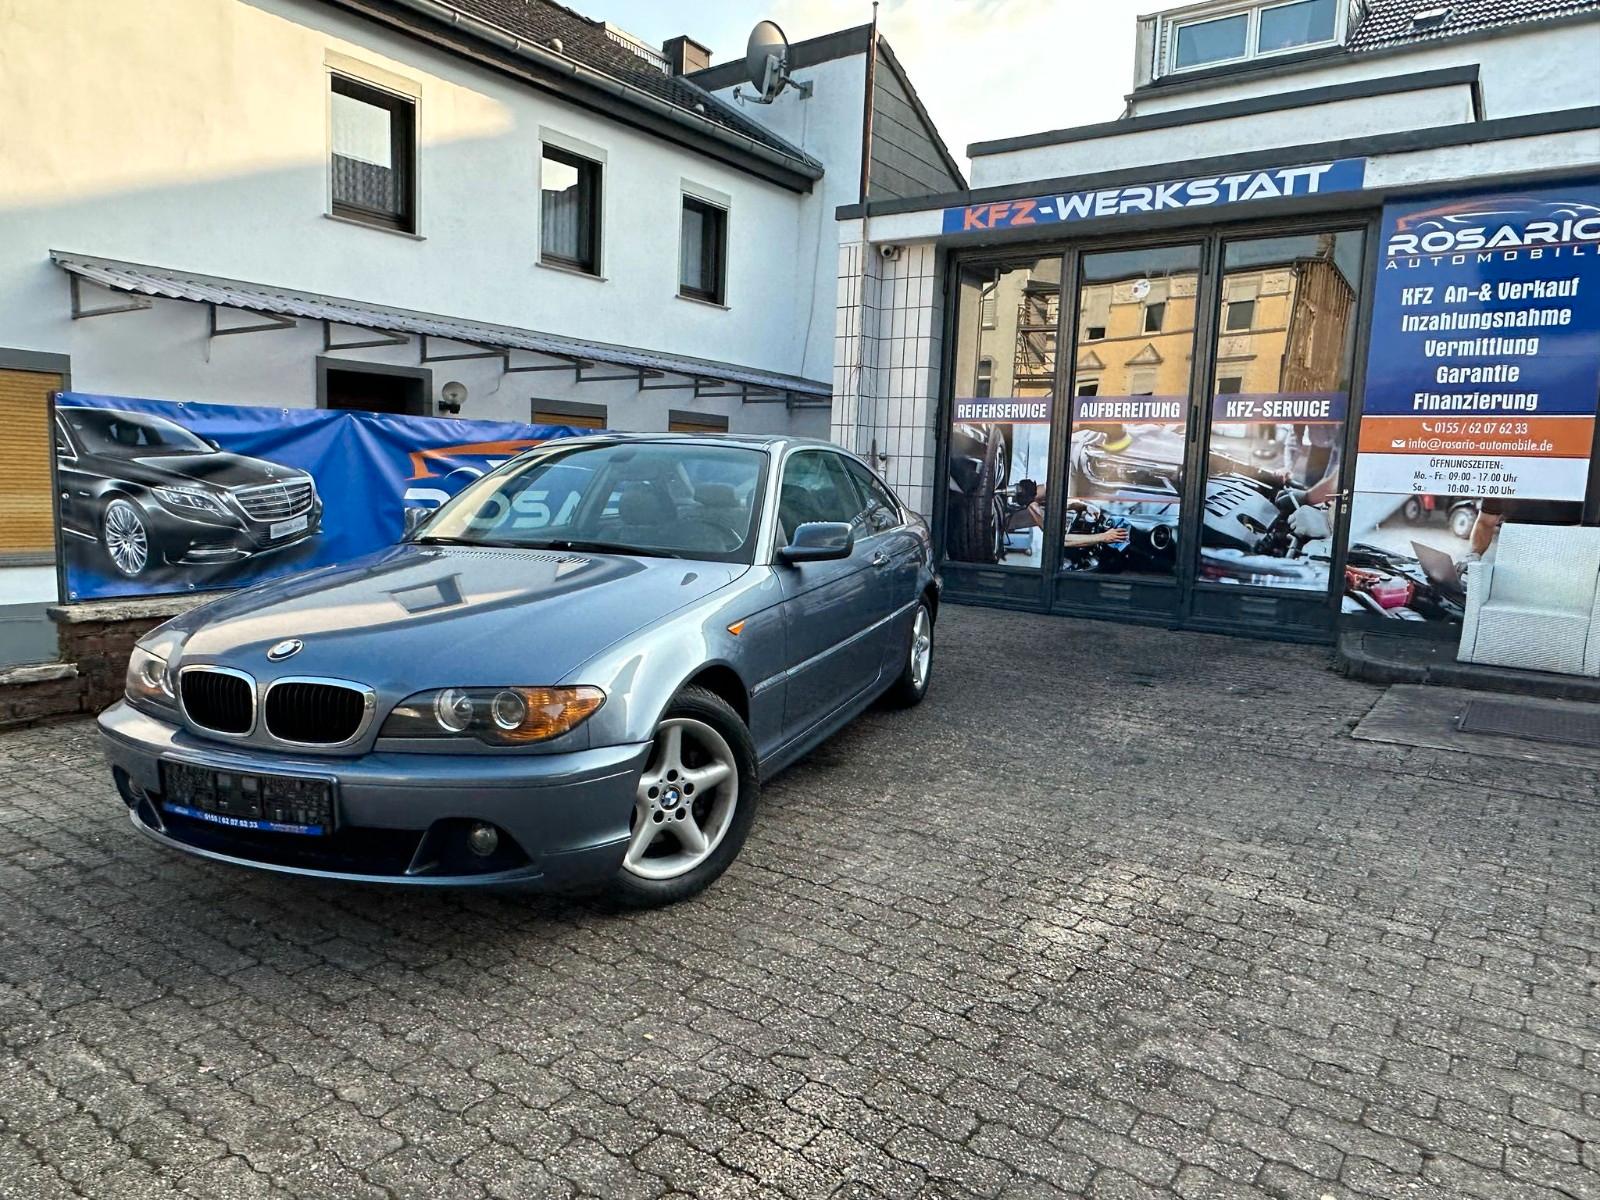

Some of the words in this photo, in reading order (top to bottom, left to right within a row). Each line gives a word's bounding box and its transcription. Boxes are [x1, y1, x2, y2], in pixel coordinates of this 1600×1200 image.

[963, 164, 1333, 231] KFZ-WERKSTATT
[1387, 217, 1600, 256] ROSARIO
[1385, 244, 1600, 270] AUTOMOBIL
[1401, 287, 1434, 306] KFZ
[1498, 277, 1580, 300] Verkauf
[1402, 308, 1572, 332] Inzahlungsnahme
[1424, 337, 1539, 357] Vermittlung
[1436, 365, 1520, 384] Garantie
[957, 402, 1047, 419] REIFENSERVICE
[1079, 401, 1181, 418] AUFBEREITUNG
[1226, 400, 1330, 418] KFZ-SERVICE
[1413, 393, 1538, 411] Finanzierung
[1434, 422, 1459, 434] 0155
[1468, 423, 1482, 434] 62
[1483, 423, 1496, 434] 07
[1499, 423, 1512, 434] 62
[1514, 423, 1528, 435] 33
[1408, 437, 1553, 451] info@rosario-automobile.de
[1502, 473, 1518, 483] Uhr
[1447, 484, 1469, 493] 10:00
[1501, 486, 1516, 495] Uhr
